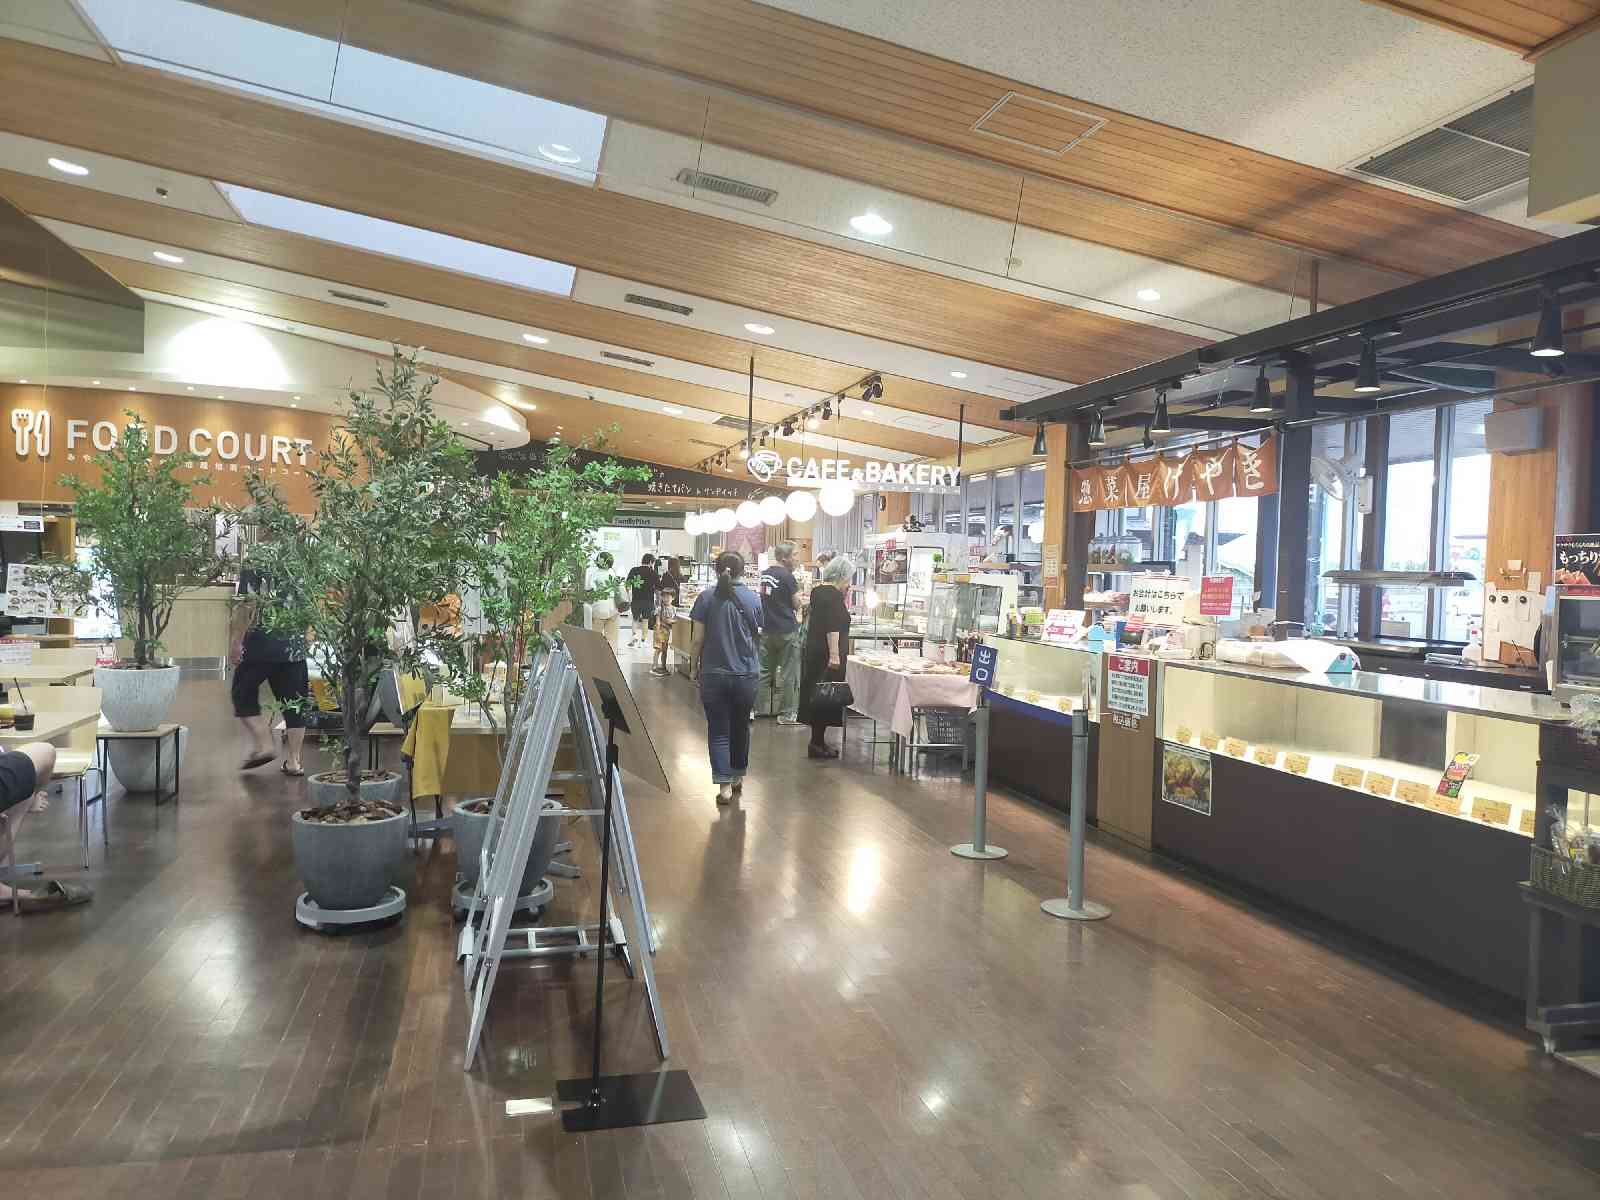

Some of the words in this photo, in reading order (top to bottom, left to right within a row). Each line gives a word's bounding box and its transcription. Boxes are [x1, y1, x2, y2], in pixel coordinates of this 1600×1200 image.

[188, 428, 313, 466] COURT
[785, 456, 850, 480] CAFE
[852, 468, 864, 482] &
[865, 461, 961, 487] BAKERY
[1078, 452, 1265, 505] 惣菜屋けやき
[1559, 550, 1600, 565] もっちり
[1132, 588, 1185, 601] お会計はこちらで
[975, 649, 991, 681] 出口
